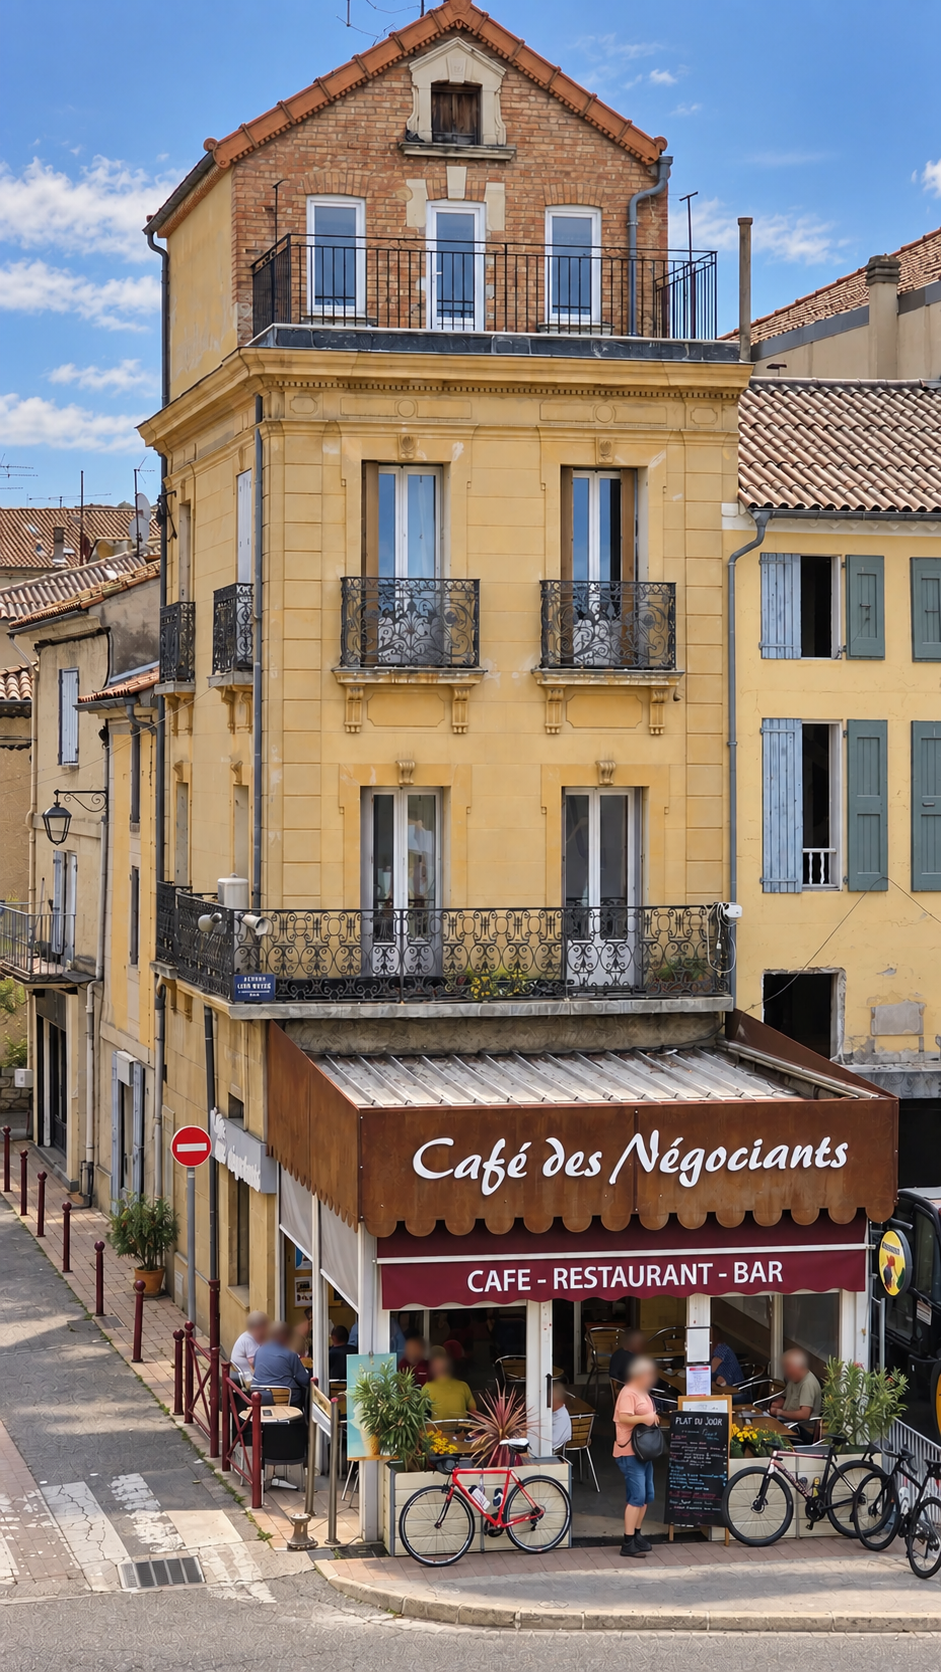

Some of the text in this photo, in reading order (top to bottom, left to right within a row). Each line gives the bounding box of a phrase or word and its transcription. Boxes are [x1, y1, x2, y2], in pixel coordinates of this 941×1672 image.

[412, 1129, 849, 1196] Café des Négociants
[467, 1268, 531, 1293] CAFE
[553, 1263, 714, 1290] RESTAURANT
[733, 1260, 784, 1284] BAR
[675, 1416, 693, 1425] PLAT
[694, 1417, 703, 1426] DU
